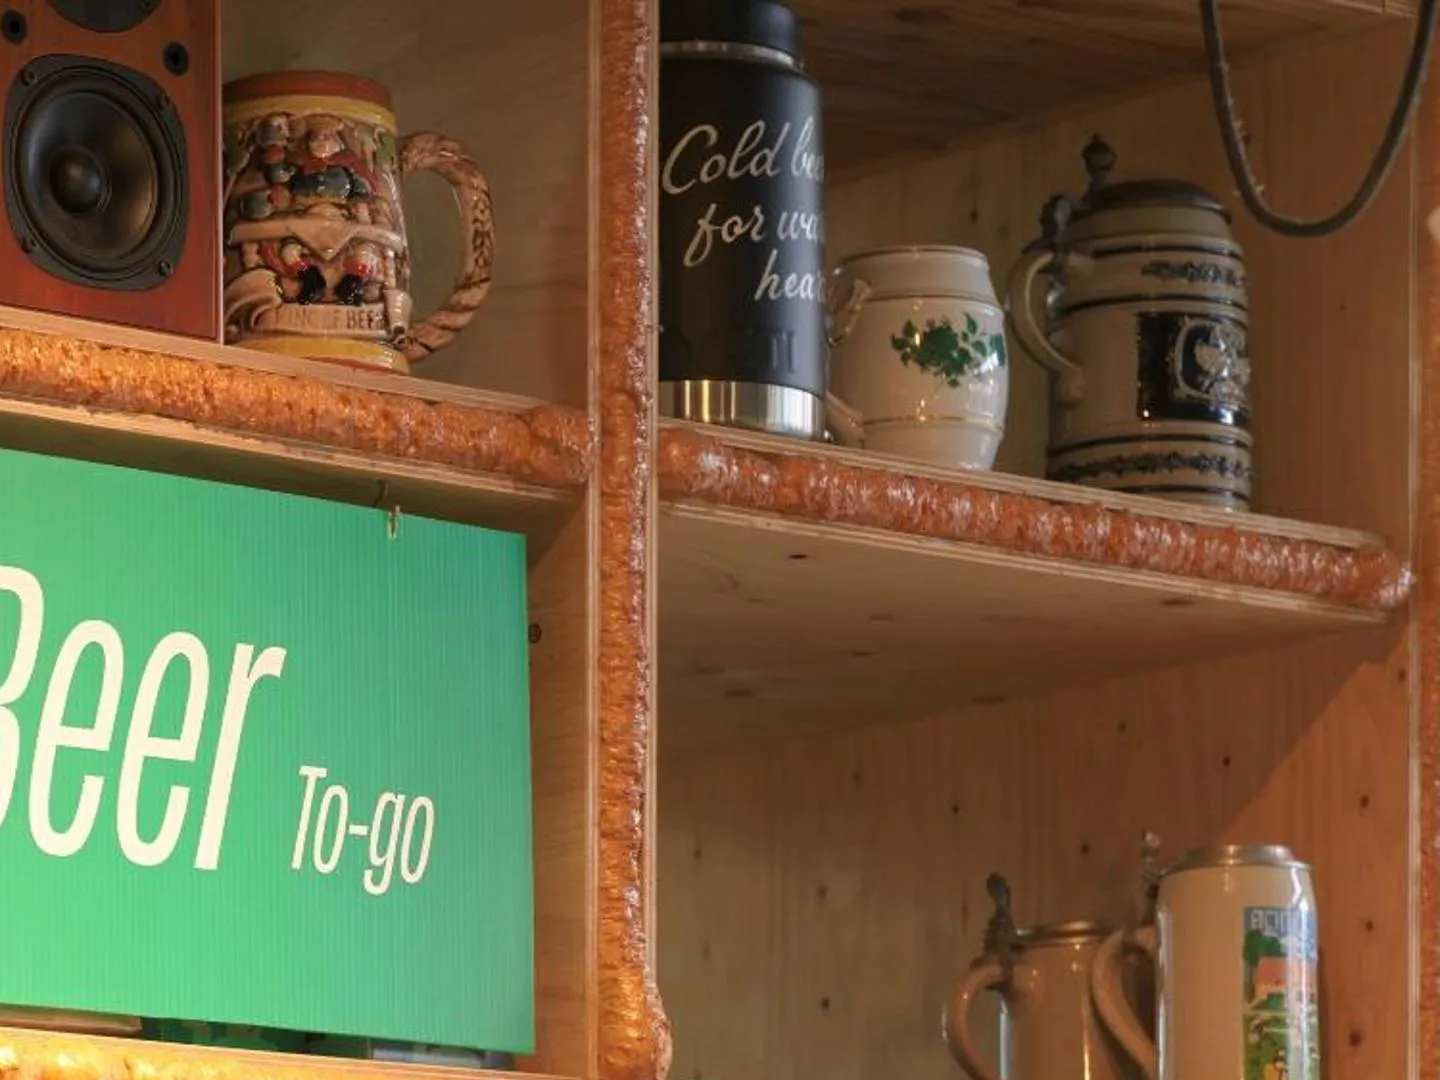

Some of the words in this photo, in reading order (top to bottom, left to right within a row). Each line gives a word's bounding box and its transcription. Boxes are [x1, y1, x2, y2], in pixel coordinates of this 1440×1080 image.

[662, 120, 791, 194] Cold
[683, 202, 766, 267] for
[290, 764, 436, 897] To-go
